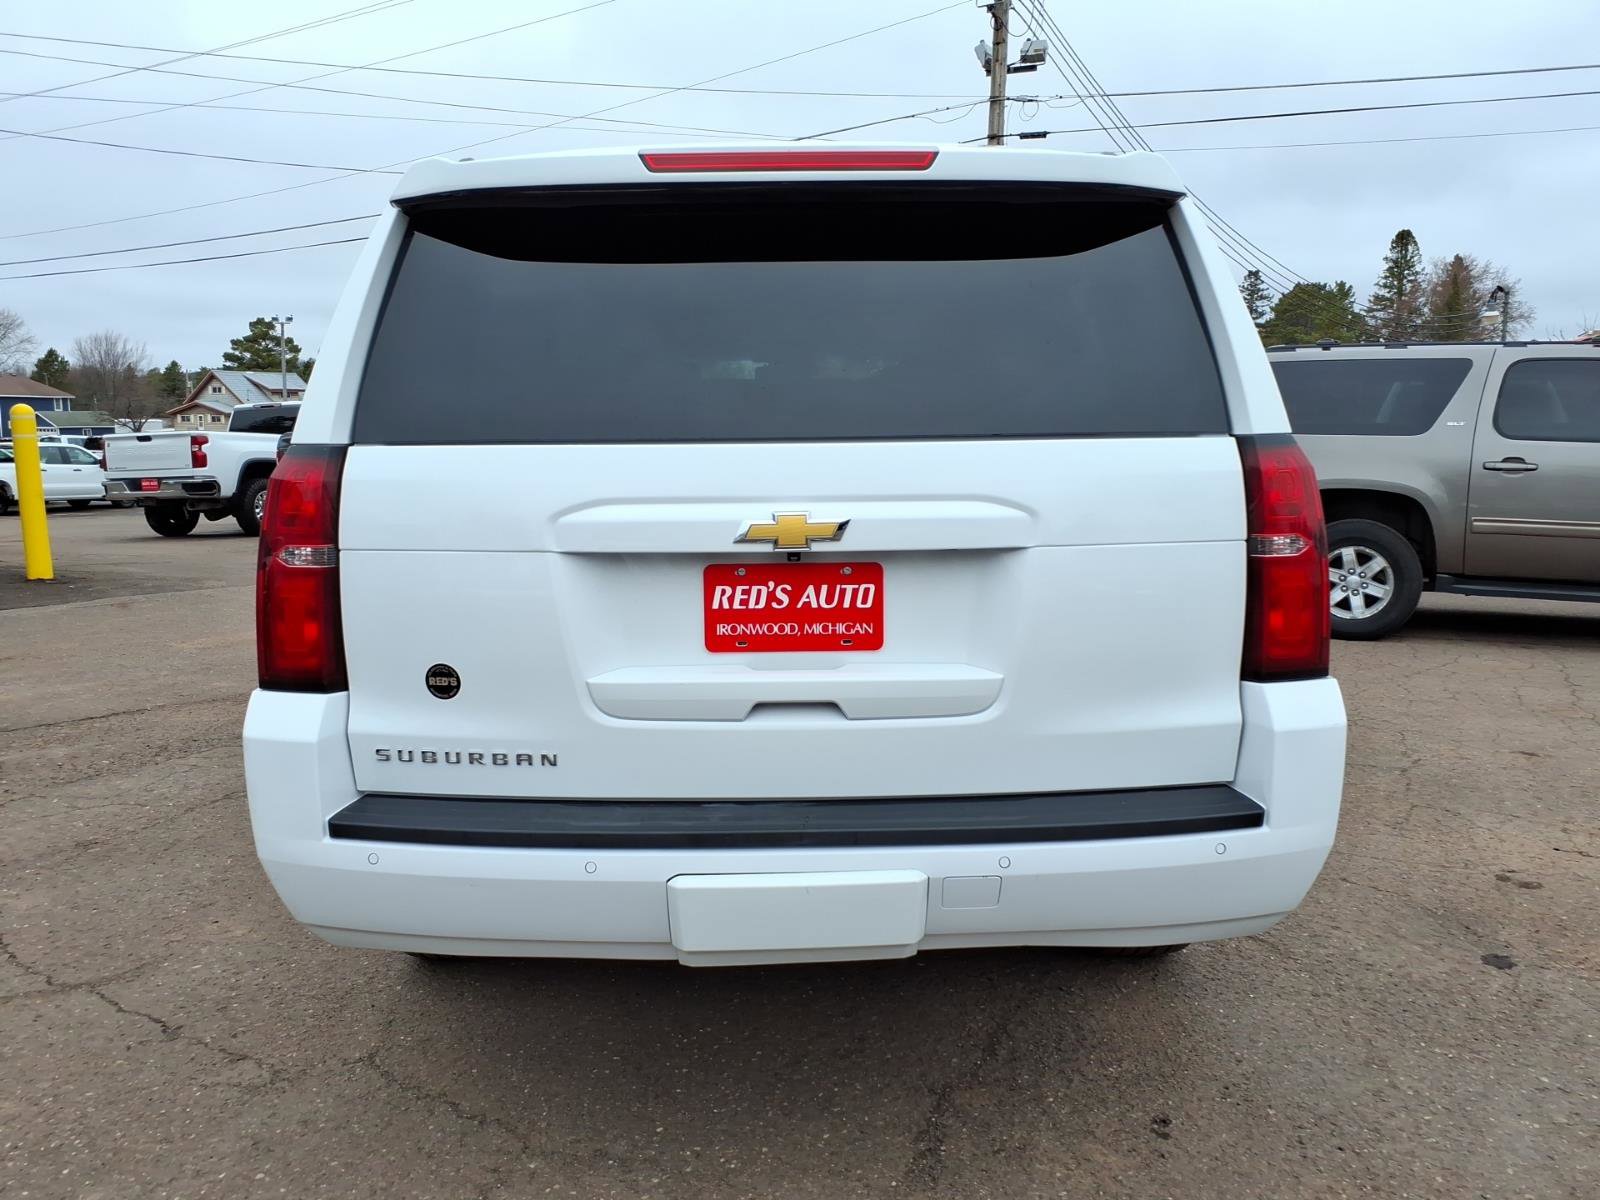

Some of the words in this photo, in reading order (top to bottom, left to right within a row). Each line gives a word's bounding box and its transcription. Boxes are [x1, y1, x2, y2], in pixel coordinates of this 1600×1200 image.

[712, 581, 792, 609] RED'S
[797, 583, 876, 609] AUTO
[716, 623, 801, 637] IRONWOOD,
[803, 622, 873, 635] MICHIGAN
[429, 676, 458, 686] RED'S
[375, 749, 558, 767] SUBURBAN
